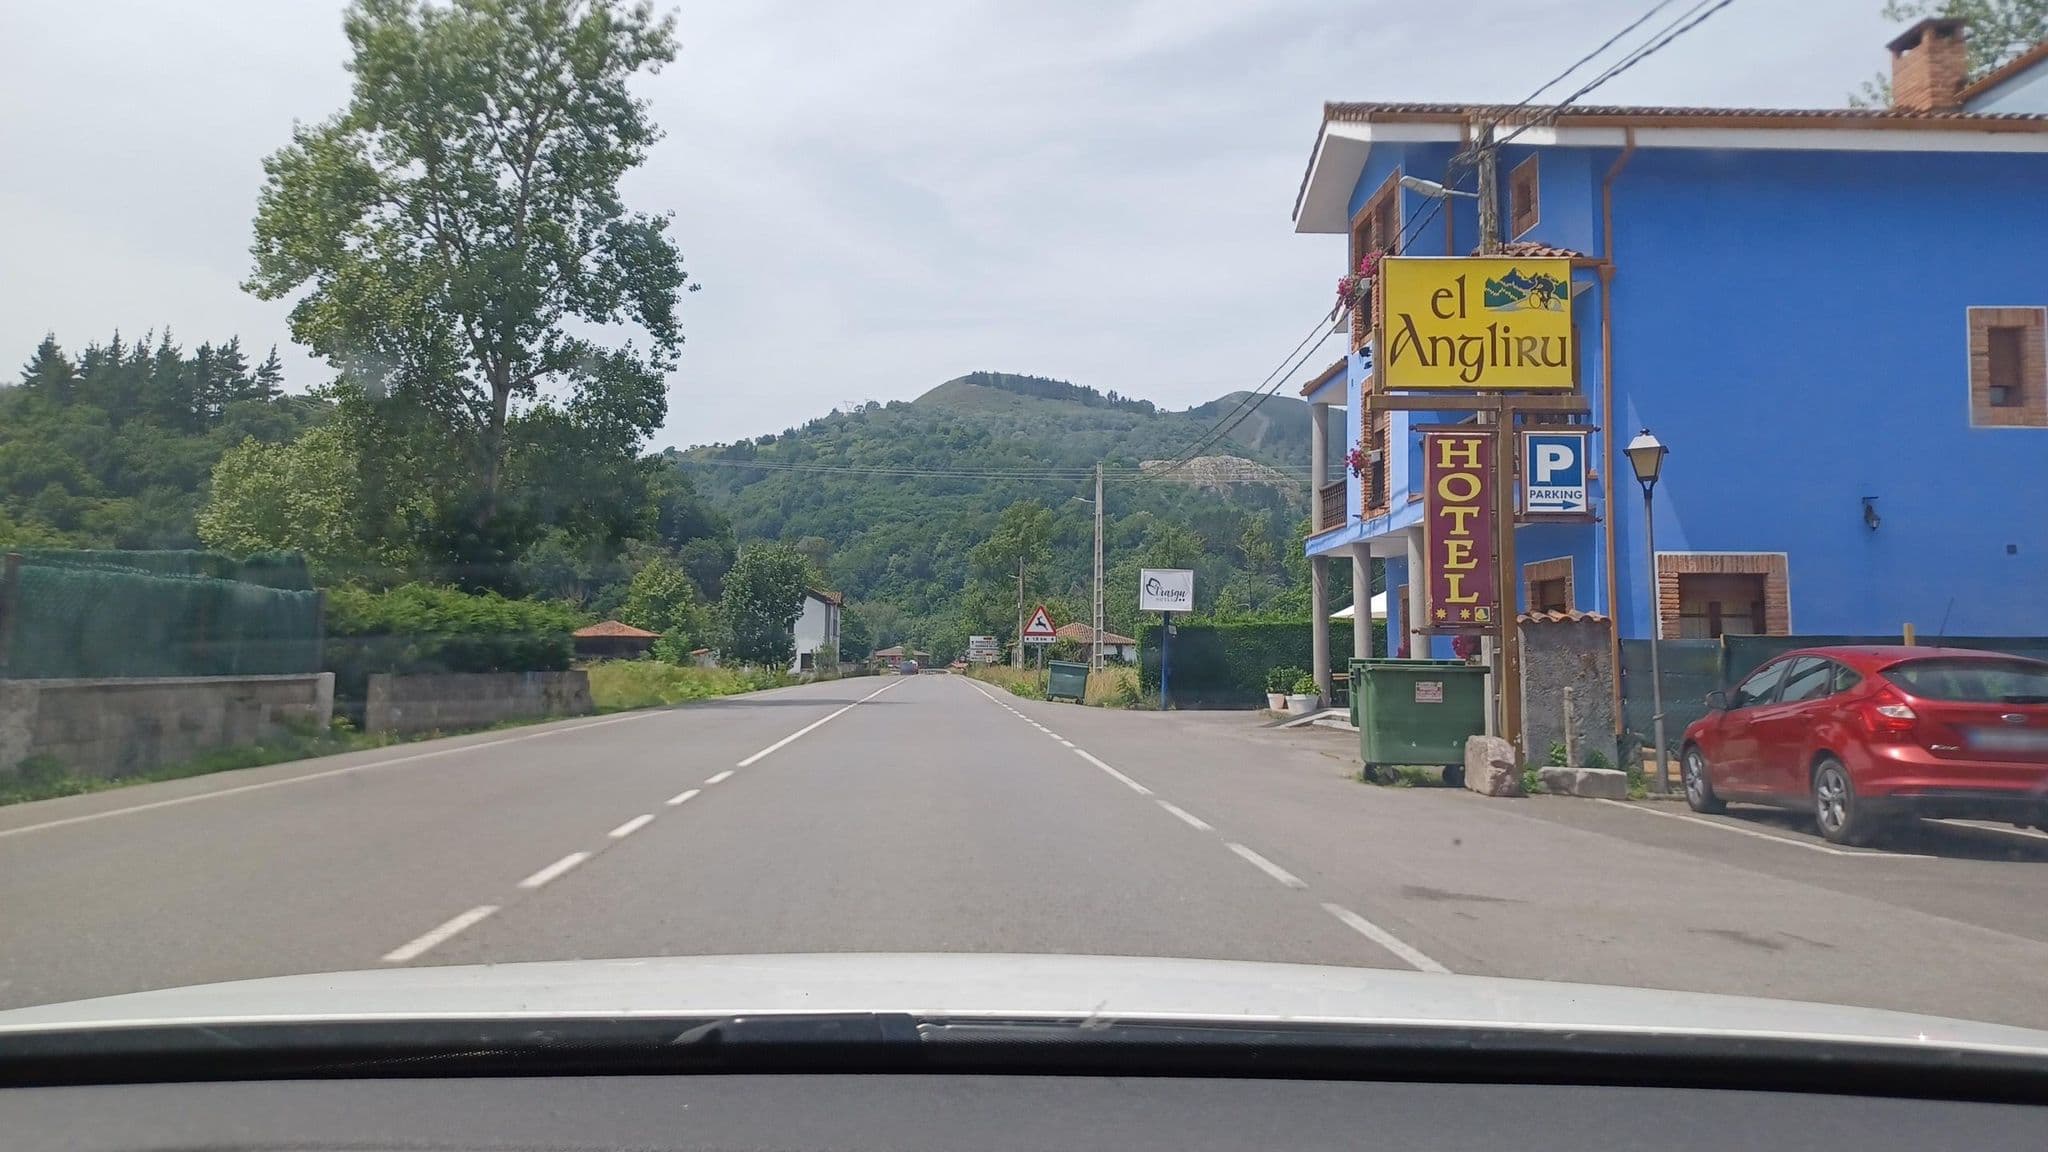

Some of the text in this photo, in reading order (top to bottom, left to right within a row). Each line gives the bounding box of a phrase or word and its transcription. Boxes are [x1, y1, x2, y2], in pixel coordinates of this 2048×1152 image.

[1430, 273, 1467, 320] el
[1536, 443, 1575, 483] P
[1529, 489, 1583, 500] PARKING
[1436, 438, 1482, 604] HOTEL
